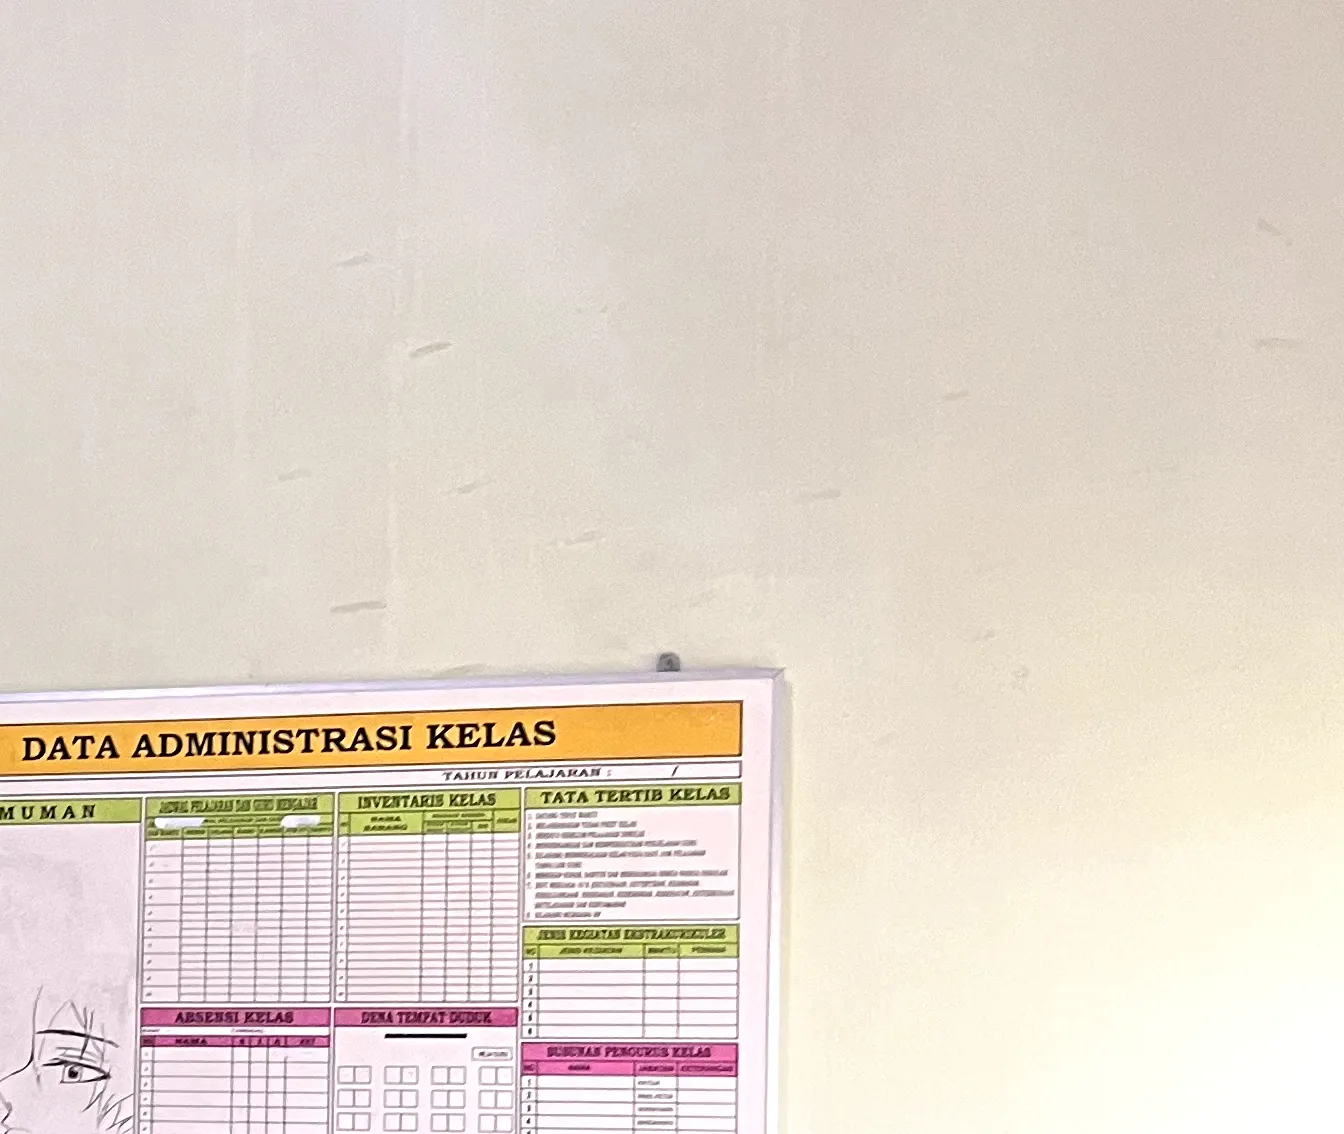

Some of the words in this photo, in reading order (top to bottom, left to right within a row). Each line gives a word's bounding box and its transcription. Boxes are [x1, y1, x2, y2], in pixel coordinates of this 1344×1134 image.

[21, 735, 120, 762] DATA
[131, 724, 411, 759] ADMINISTRASI
[426, 719, 557, 750] KELAS
[442, 770, 499, 782] TAHUN
[503, 767, 601, 781] PELAJARAN
[448, 792, 496, 808] KELAS
[539, 790, 590, 805] TATA
[594, 788, 663, 804] TERTIB
[669, 786, 731, 802] KELAS
